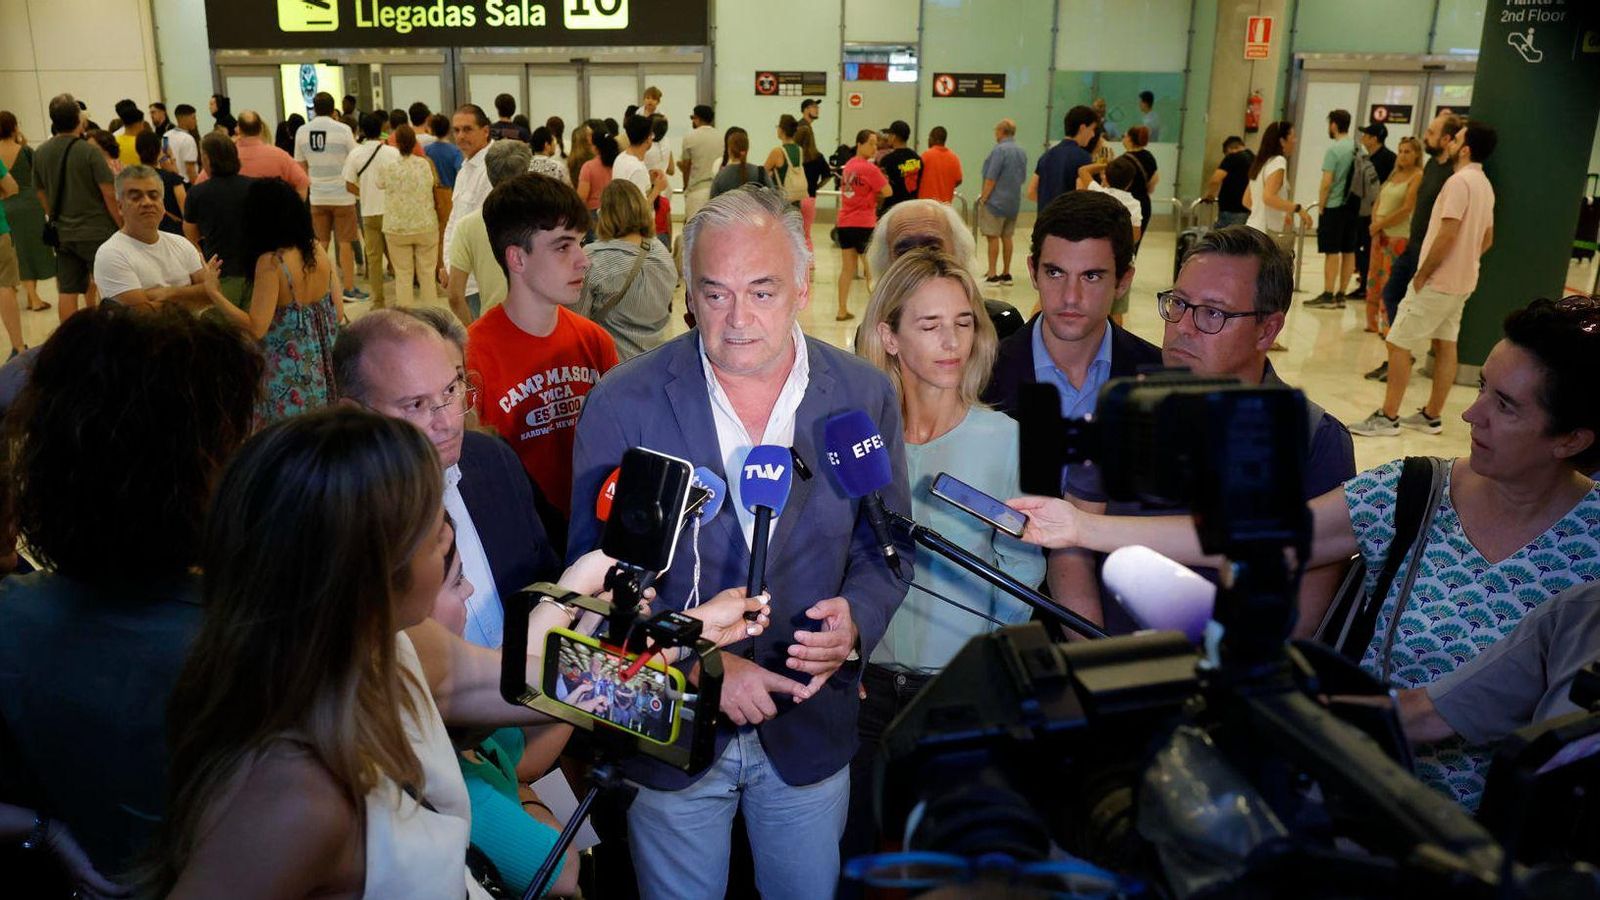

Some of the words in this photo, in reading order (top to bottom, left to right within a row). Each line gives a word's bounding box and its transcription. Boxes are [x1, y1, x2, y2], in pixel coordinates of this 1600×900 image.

[355, 0, 476, 33] Llegadas
[485, 0, 546, 27] Sala
[1501, 9, 1526, 22] 2nd
[1527, 8, 1566, 22] Floor
[311, 133, 325, 149] 10
[498, 373, 545, 414] CAMP
[545, 365, 601, 386] MASON
[554, 399, 581, 416] 1900
